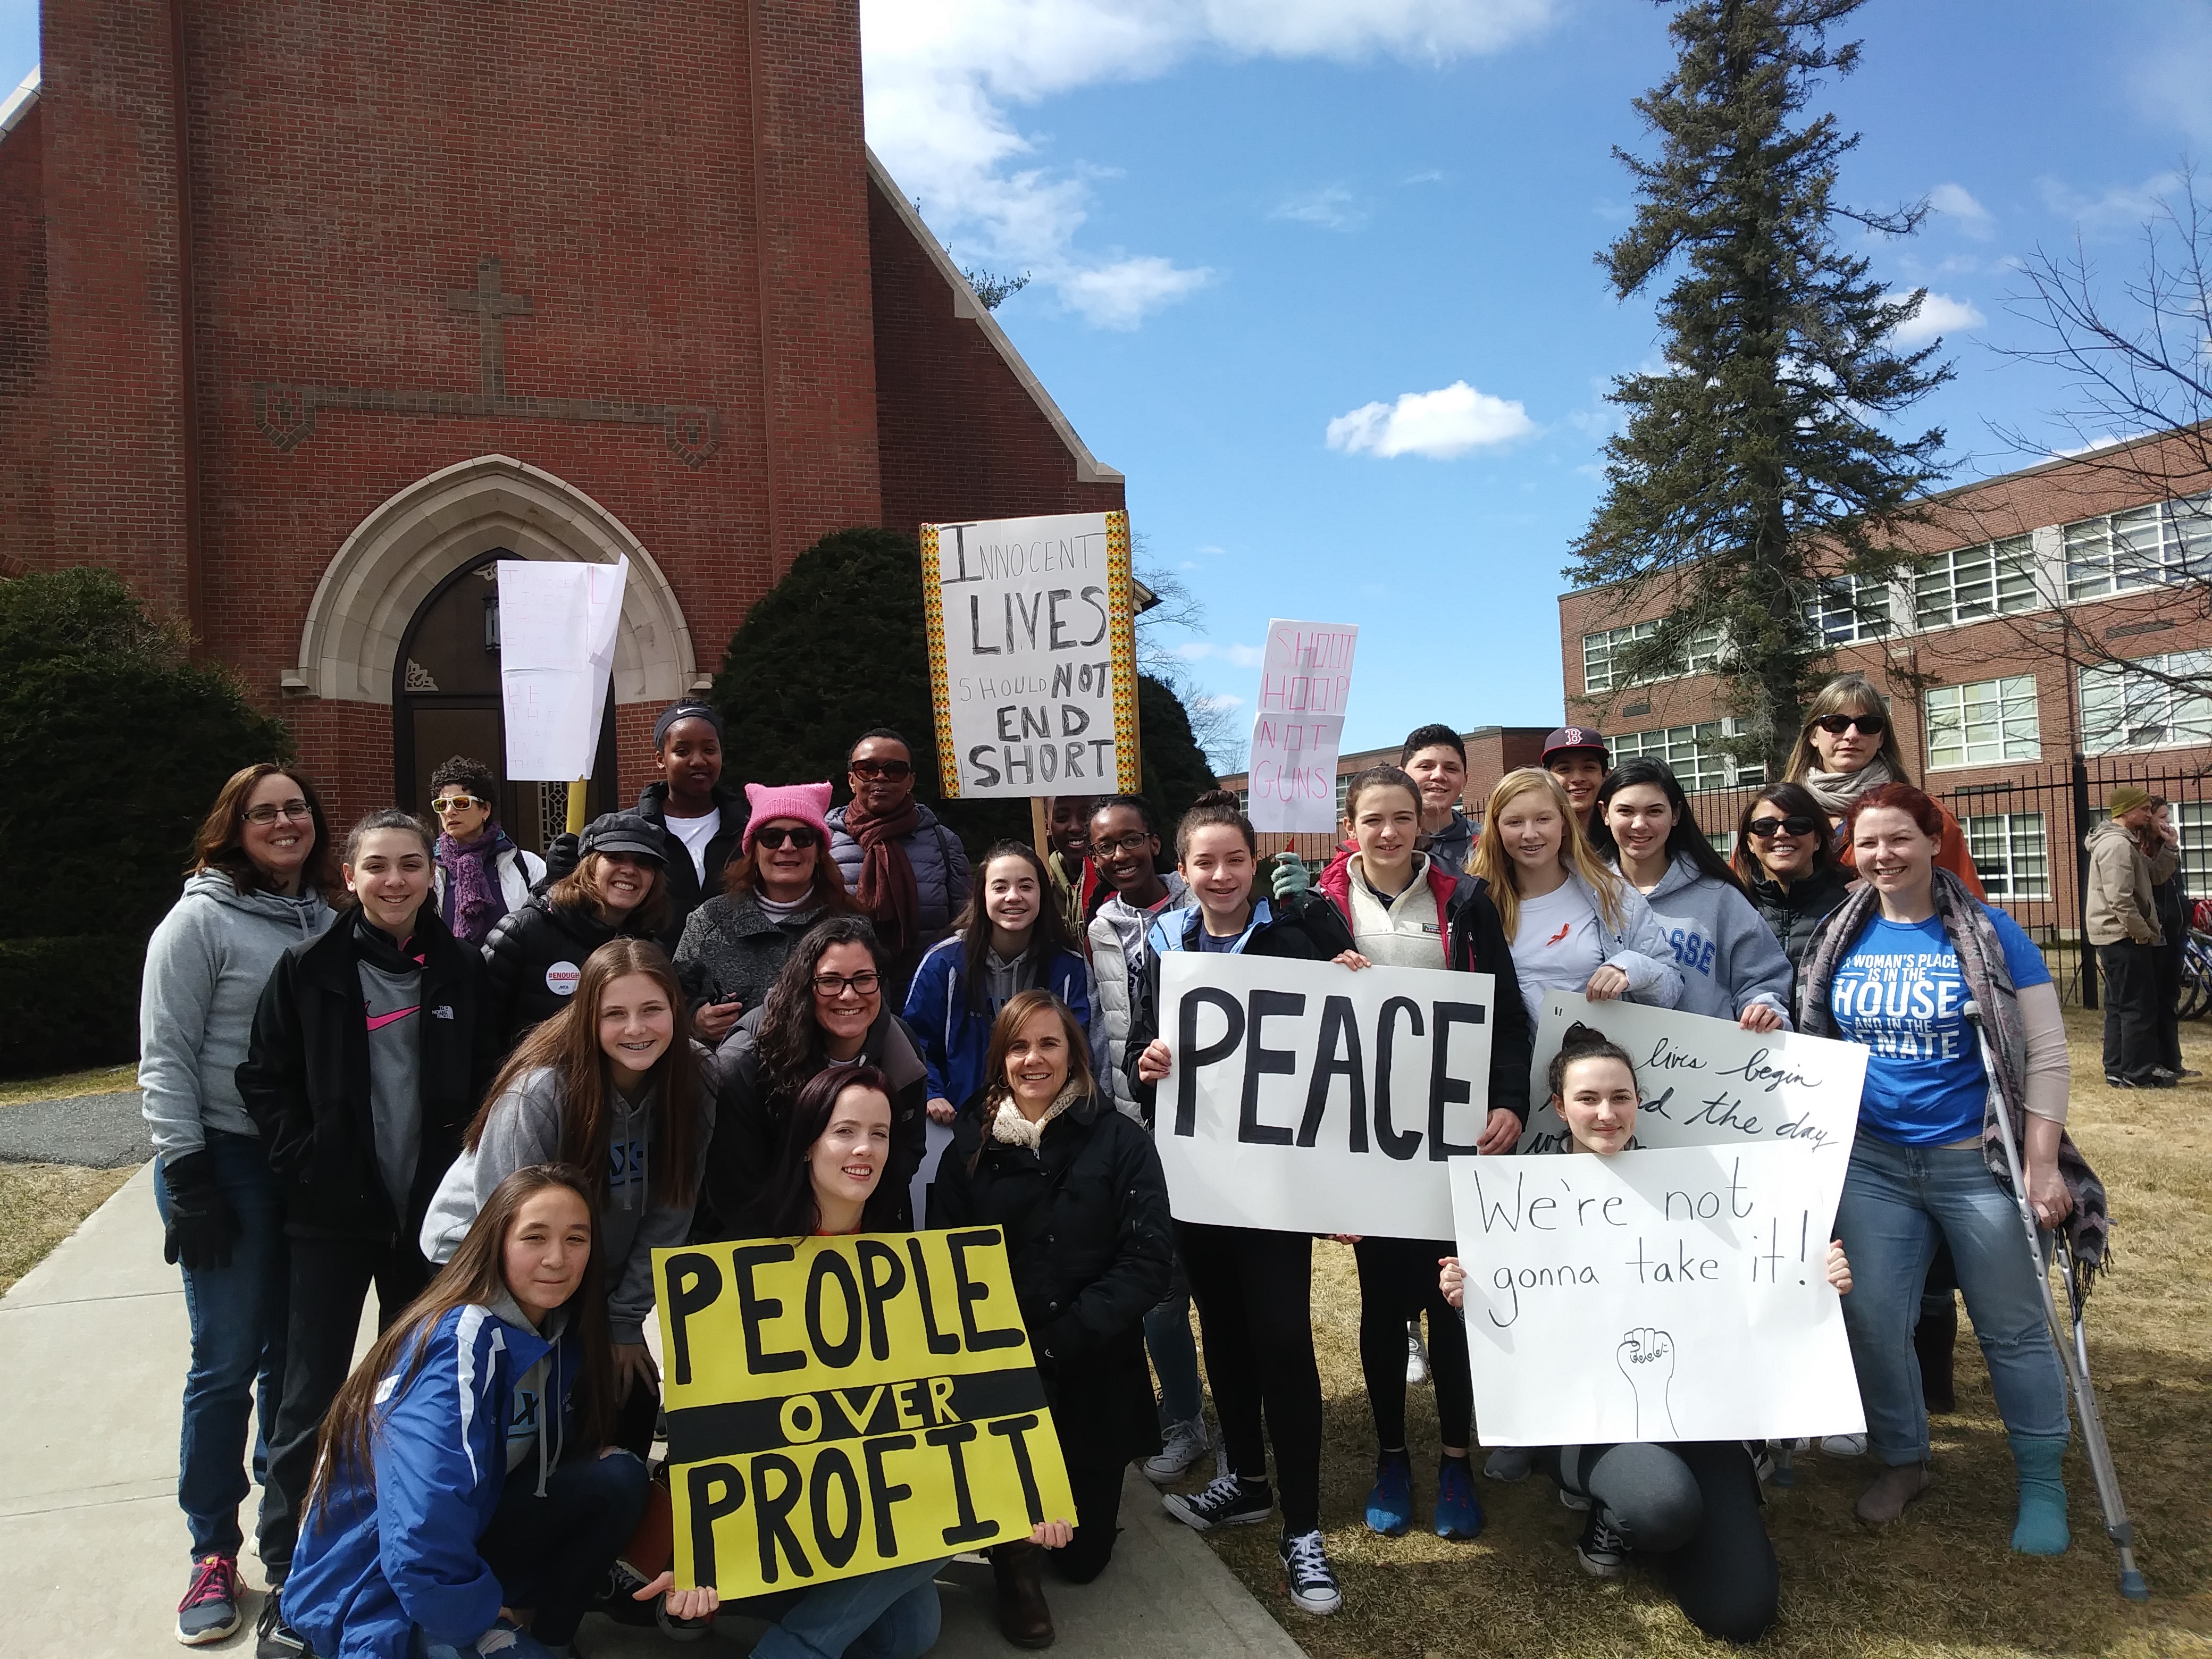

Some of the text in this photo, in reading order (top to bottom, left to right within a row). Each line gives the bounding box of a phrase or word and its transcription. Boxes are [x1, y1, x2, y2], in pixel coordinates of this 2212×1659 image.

[940, 523, 1107, 585] INNOCENT
[970, 585, 1107, 655] LIVES
[1270, 628, 1355, 668] SHOOT
[507, 683, 540, 705] BE
[959, 662, 1111, 702] SHOULD NOT
[508, 707, 560, 723] THE
[996, 704, 1091, 743] END
[1260, 720, 1328, 751] NOT
[1565, 728, 1583, 745] B
[968, 740, 1114, 787] SHORT
[1254, 760, 1328, 803] GUNS
[1663, 927, 1716, 977] SSE
[1854, 954, 1917, 969] WOMAN'S
[1917, 953, 1959, 969] PLACE
[1867, 967, 1928, 982] IS IN THE
[1834, 977, 1960, 1019] HOUSE
[1855, 1017, 1933, 1033] AND IN THE
[1174, 986, 1486, 1162] PEACE
[1635, 1037, 1823, 1092] lives begin
[1683, 1091, 1764, 1134] the
[1775, 1111, 1839, 1152] day
[1473, 1156, 1753, 1234] We're not
[1488, 1210, 1808, 1328] gonna take it!
[664, 1228, 1026, 1386] PEOPLE
[779, 1376, 962, 1444] OVER
[687, 1413, 1044, 1590] PROFIT
